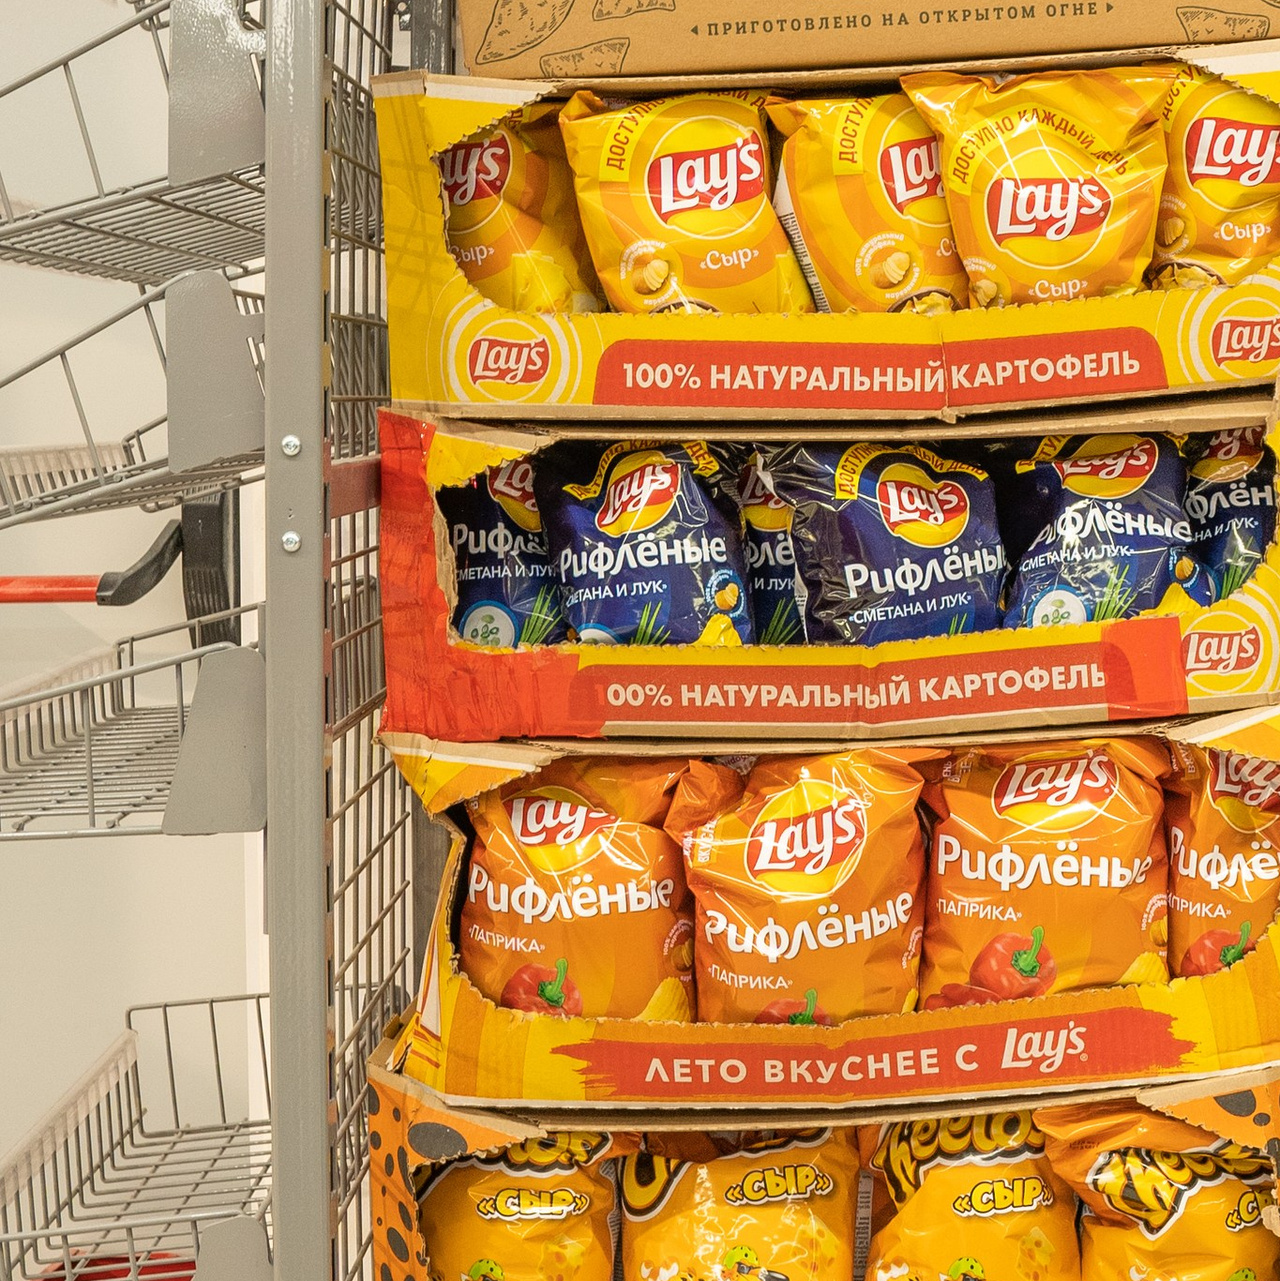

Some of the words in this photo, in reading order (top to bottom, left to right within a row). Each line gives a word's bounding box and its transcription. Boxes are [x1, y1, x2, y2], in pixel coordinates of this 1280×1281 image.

[706, 13, 873, 37] ПРИГОТОВЛЕНО
[882, 12, 910, 27] НА
[918, 4, 1036, 26] ОТКРЫТОМ
[1045, 2, 1099, 20] ОГНЕ
[1213, 222, 1272, 243] «Сыр»
[699, 247, 760, 271] «Сыр»
[1028, 278, 1089, 299] «Сыр»
[622, 362, 702, 389] 100%
[710, 359, 946, 394] НАТУРАЛЬНЫЙ
[951, 350, 1141, 390] КАРТОФЕЛЬ
[616, 584, 627, 598] И
[631, 580, 668, 595] ЛУК»
[849, 605, 924, 624] «СМЕТАНА
[927, 599, 937, 613] И
[939, 592, 972, 610] ЛУК»
[681, 675, 911, 709] НАТУРАЛЬНЫЙ
[918, 663, 1106, 703] КАРТОФЕЛЬ
[469, 863, 674, 924] Рифлёные
[469, 924, 545, 954] «ПАПРИКА»
[708, 964, 793, 989] «ПАПРИКА»
[644, 1055, 747, 1086] ЛЕТО
[764, 1046, 940, 1084] ВКУСНЕЕ
[955, 1043, 978, 1072] С
[1000, 1020, 1086, 1075] Lay's
[725, 1164, 834, 1206] «СЫР»
[952, 1176, 1055, 1218] «СЫР»
